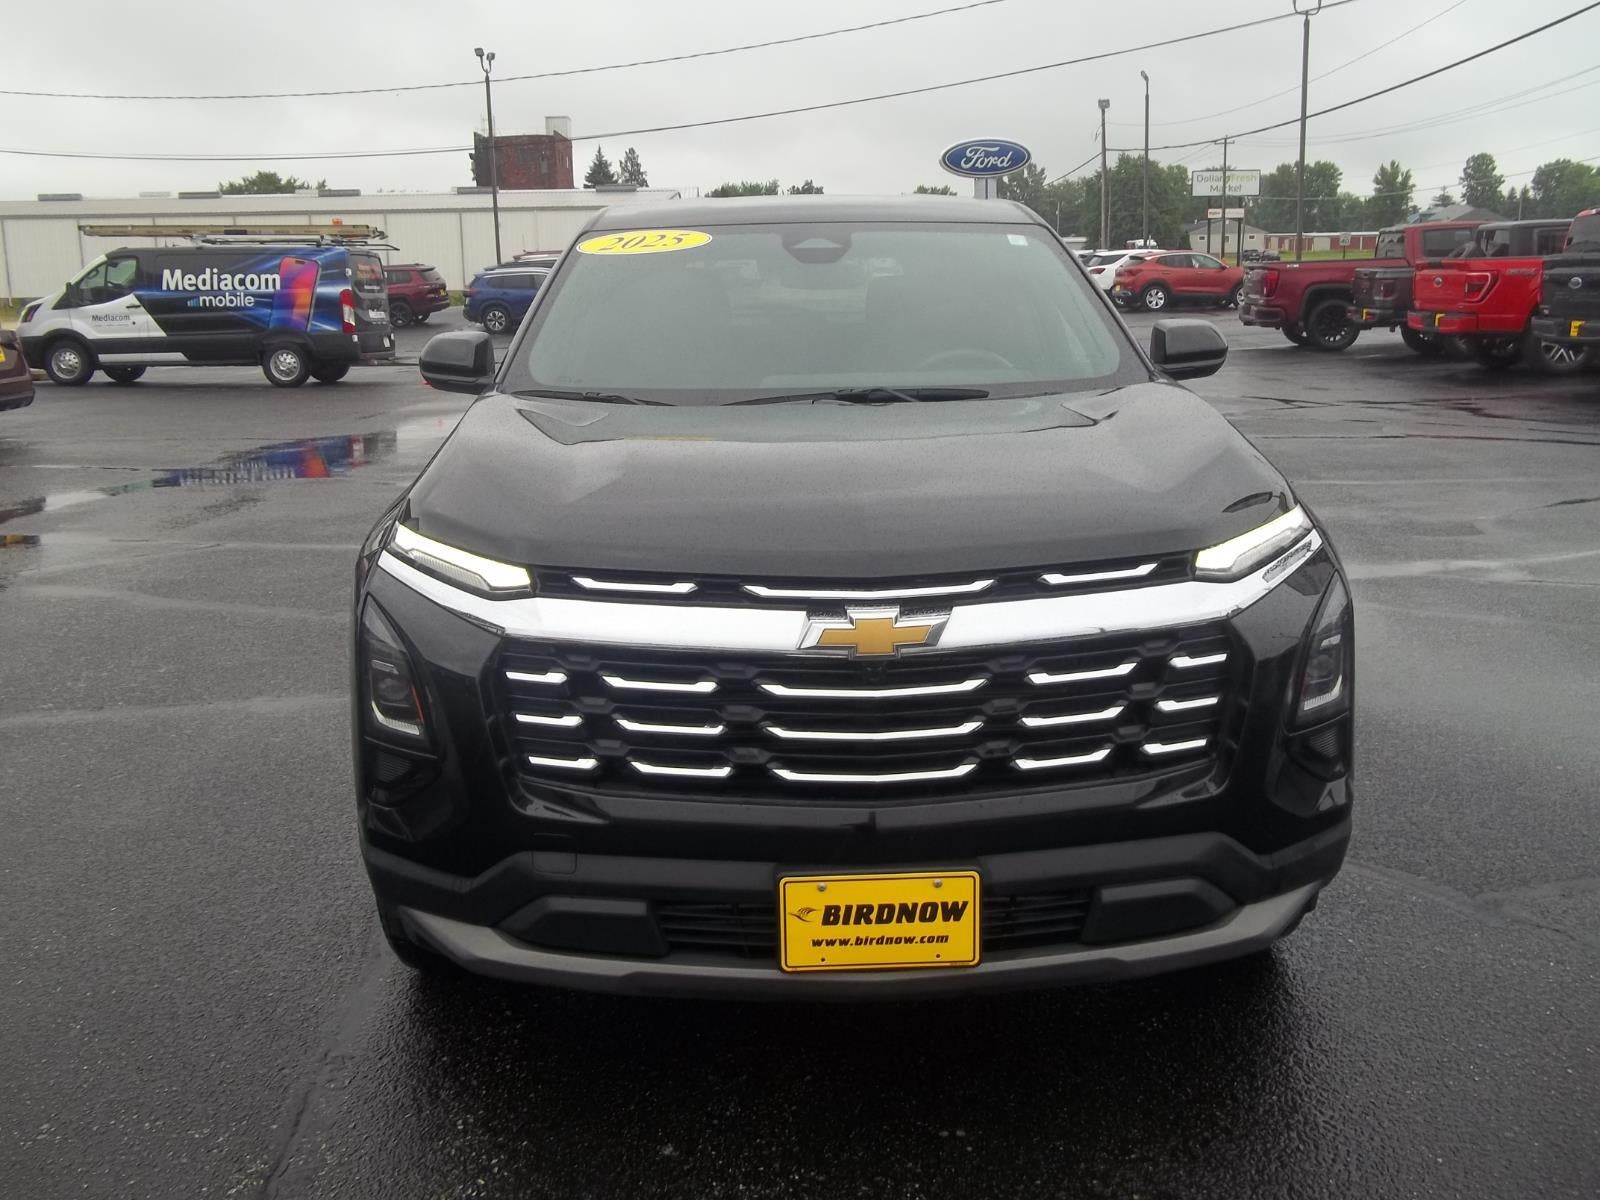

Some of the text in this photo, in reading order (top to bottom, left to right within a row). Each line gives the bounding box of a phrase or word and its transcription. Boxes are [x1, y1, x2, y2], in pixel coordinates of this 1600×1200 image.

[960, 146, 1013, 169] Ford
[598, 233, 691, 252] 2025
[162, 268, 280, 290] Mediacom
[200, 292, 255, 307] mobile
[91, 314, 130, 322] Mediacom
[821, 901, 968, 926] BIRDNOW
[812, 935, 949, 947] www.birdnow.com
